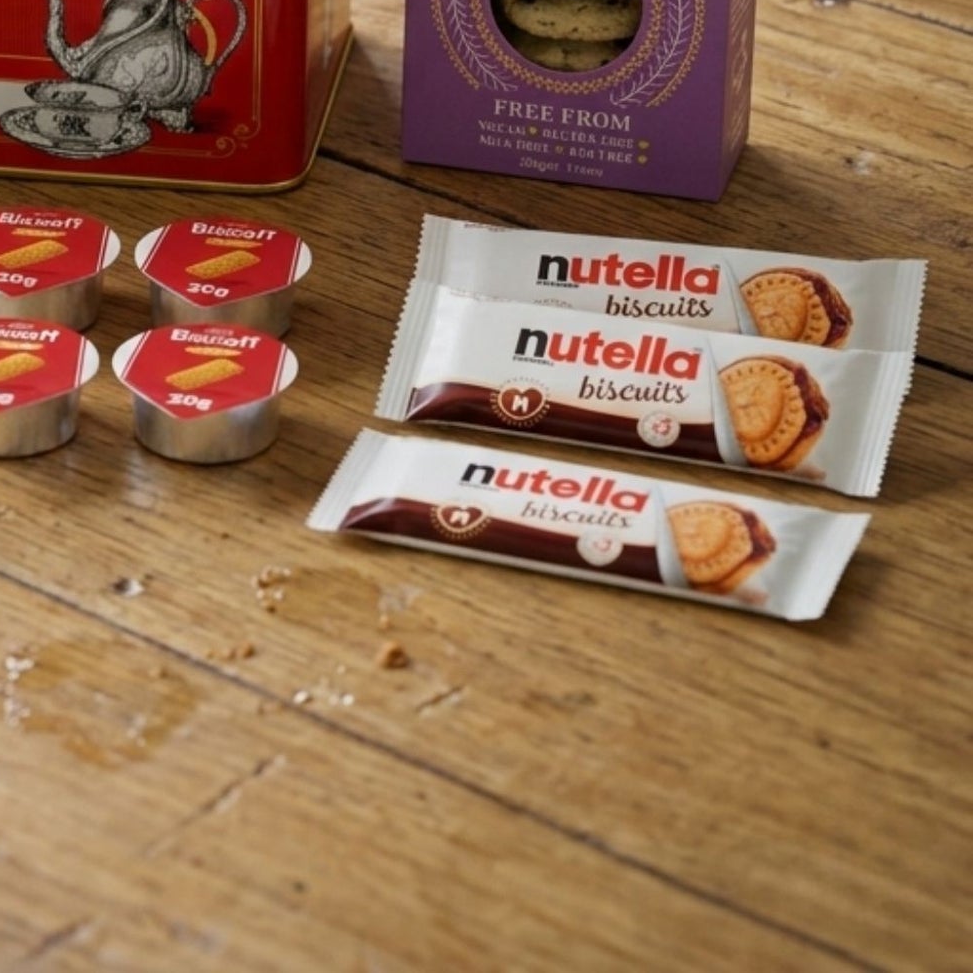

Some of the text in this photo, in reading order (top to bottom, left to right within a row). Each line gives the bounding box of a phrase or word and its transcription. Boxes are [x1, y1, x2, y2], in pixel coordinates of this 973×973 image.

[493, 98, 631, 132] FREE FROM
[536, 253, 720, 296] nutella
[604, 293, 714, 319] biscuits
[513, 326, 703, 381] nutella
[165, 392, 214, 411] 20g
[578, 375, 689, 405] biscuits
[460, 462, 650, 514] nutella
[520, 500, 634, 528] biscuits
